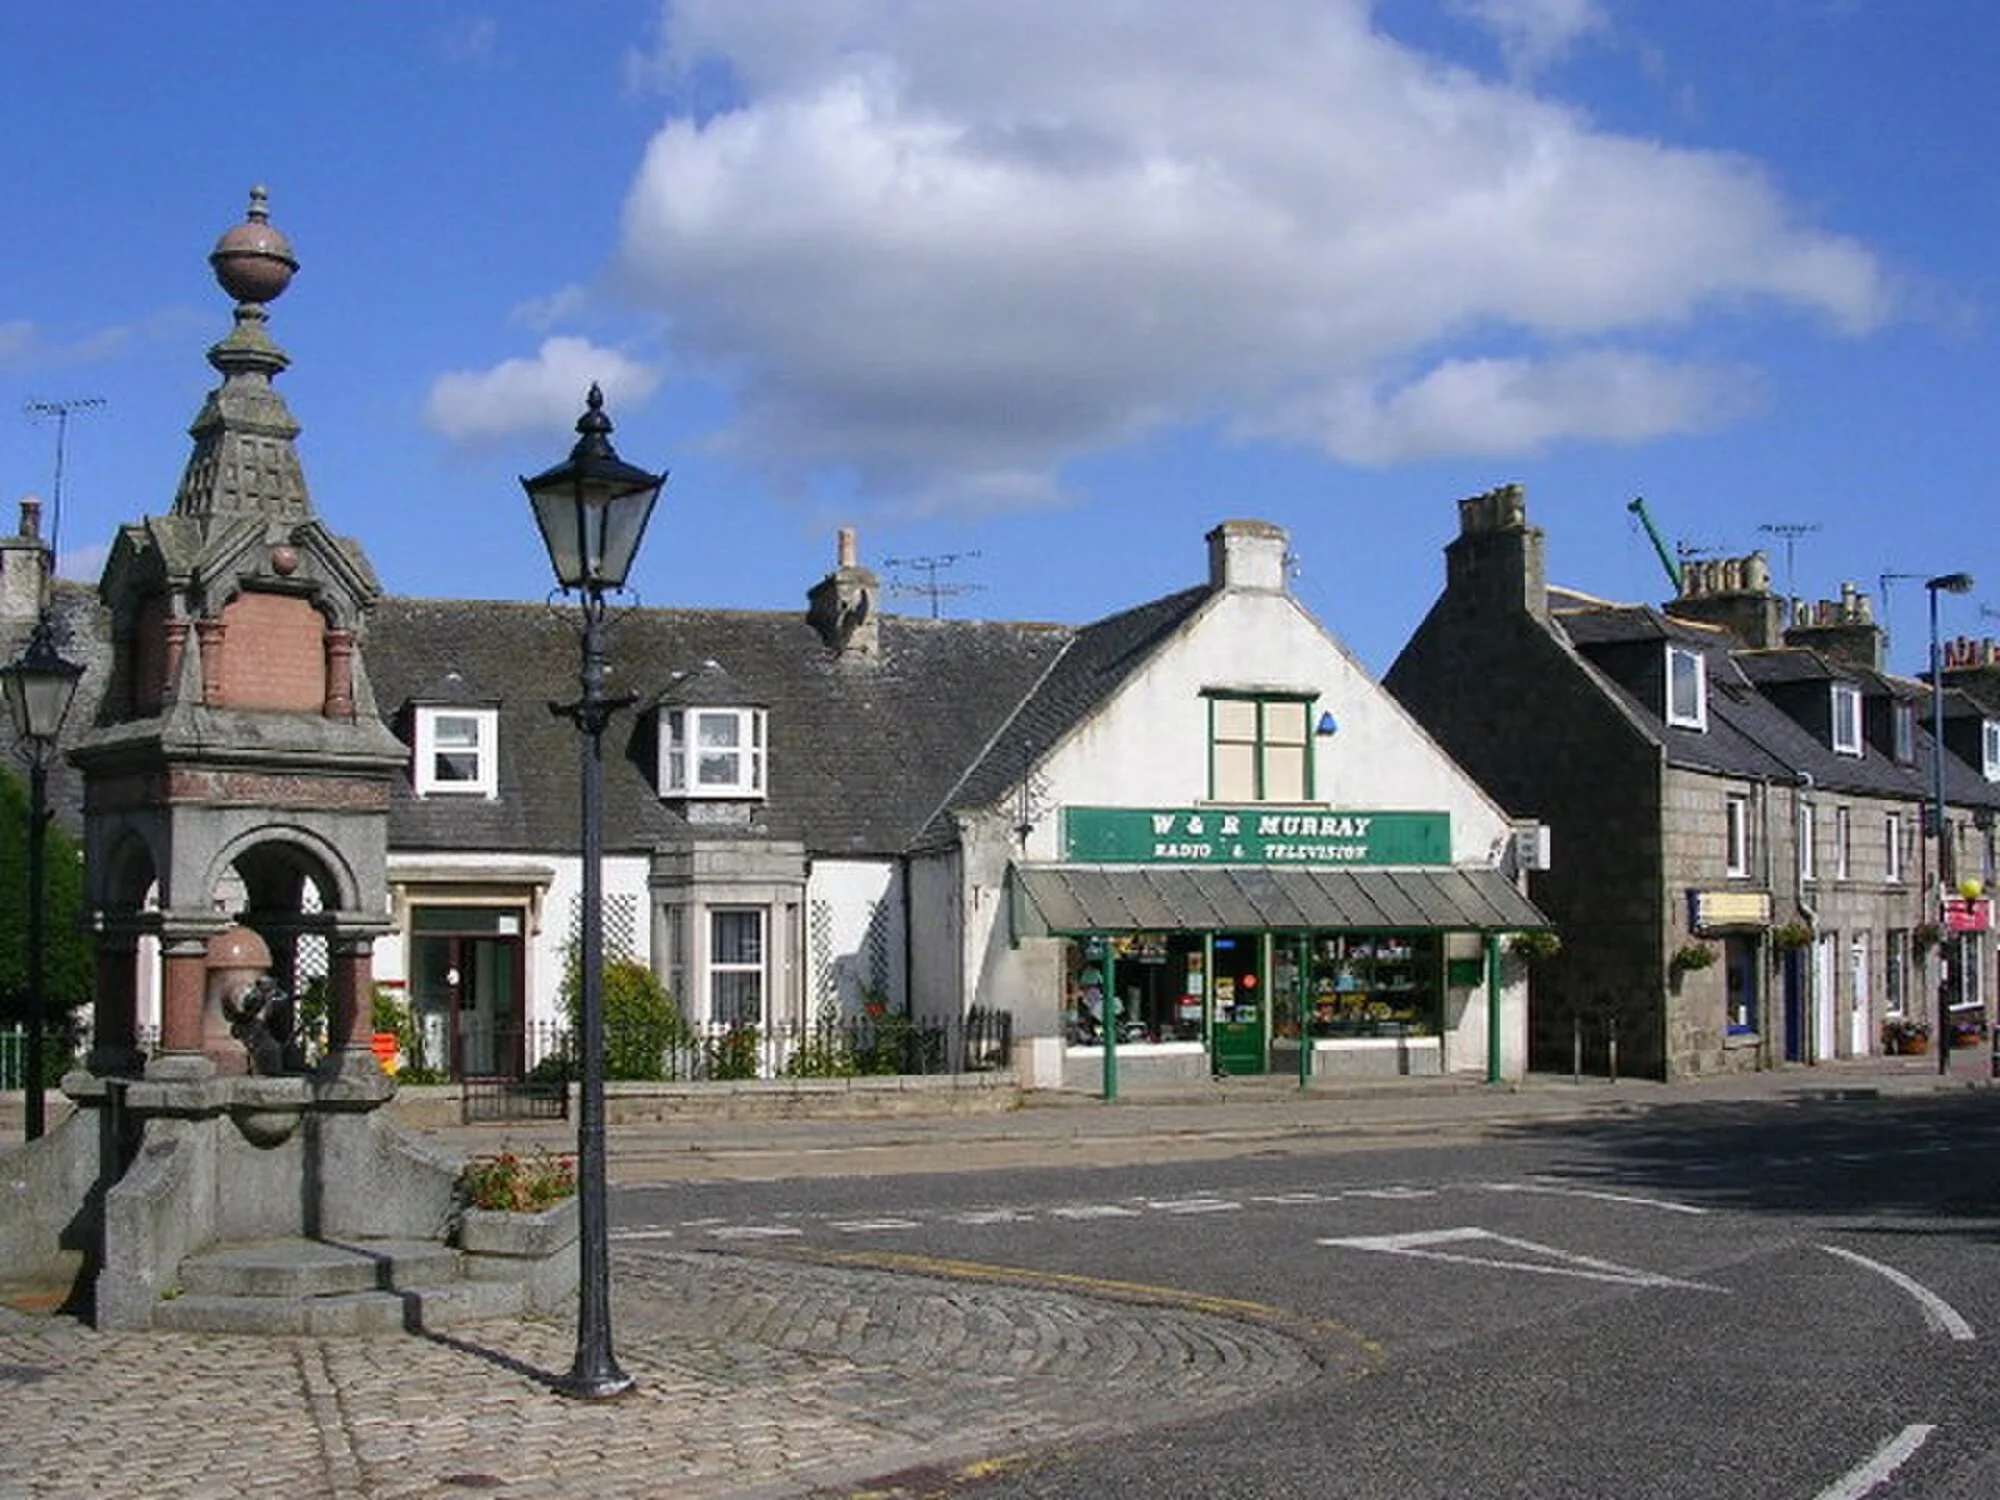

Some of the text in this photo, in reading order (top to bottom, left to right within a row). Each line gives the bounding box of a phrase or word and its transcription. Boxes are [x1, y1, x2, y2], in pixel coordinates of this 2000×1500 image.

[1152, 814, 1371, 836] W & R MURRAY
[1154, 843, 1367, 859] RADIO & TELEVISION
